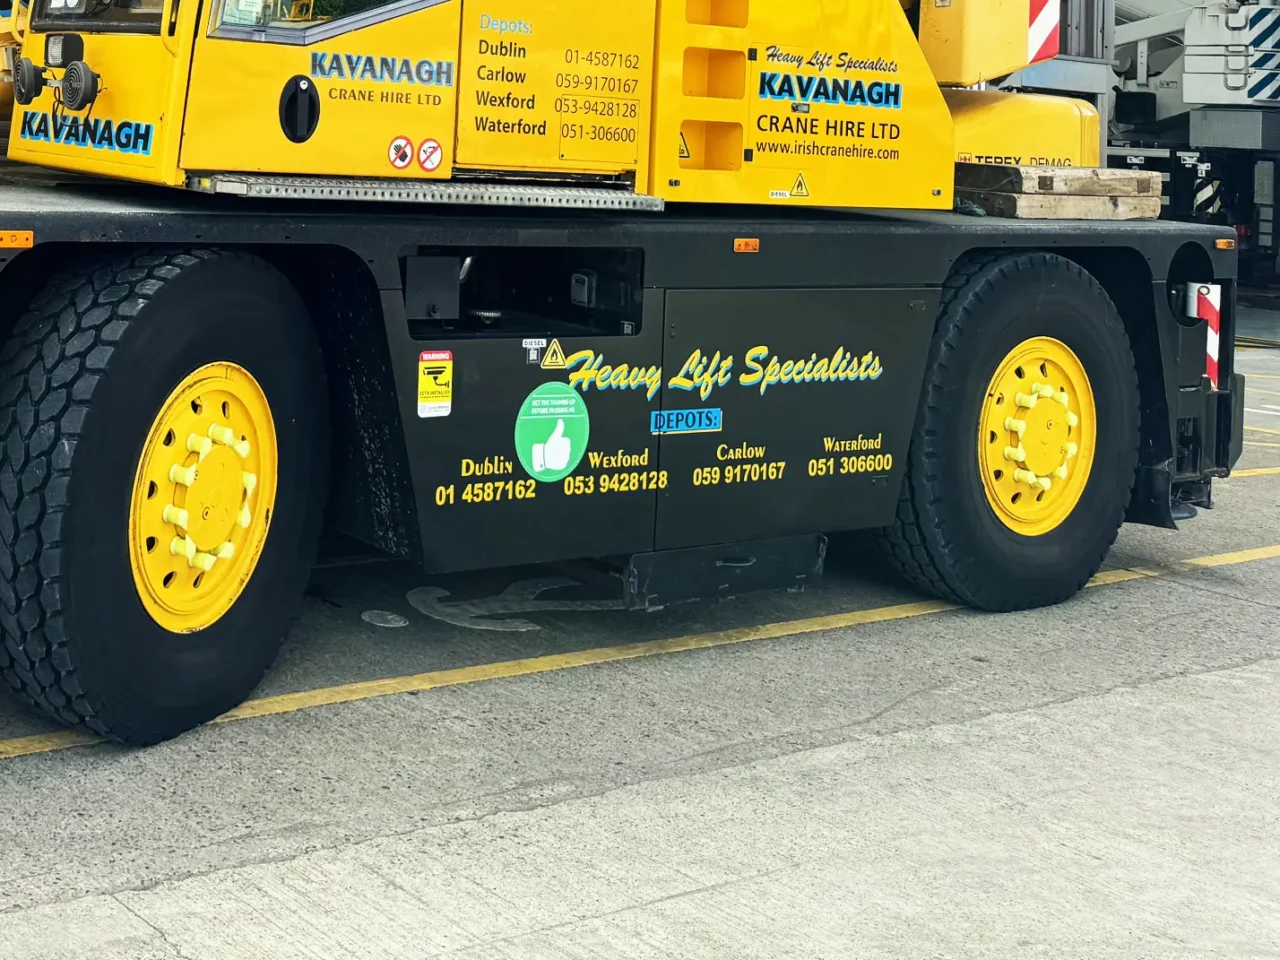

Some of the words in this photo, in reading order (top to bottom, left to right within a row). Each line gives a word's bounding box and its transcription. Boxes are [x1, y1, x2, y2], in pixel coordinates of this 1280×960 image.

[479, 14, 534, 34] Depots:
[478, 39, 527, 59] Dublin
[564, 48, 640, 70] 01-4587162
[765, 45, 804, 70] Heavy
[805, 50, 832, 71] Lift
[834, 51, 899, 74] Specialists
[310, 51, 454, 87] KAVANAGH
[477, 64, 527, 85] Carlow
[555, 72, 639, 95] 059-9170167
[328, 88, 374, 102] CRANE
[380, 90, 412, 105] HIRE
[417, 93, 442, 107] LTD
[476, 89, 536, 111] Wexford
[554, 97, 638, 120] 053-9428128
[758, 71, 903, 110] KAVANAGH
[19, 110, 155, 156] KAVANAGH
[475, 115, 547, 137] Waterford
[561, 122, 636, 144] 051-306600
[756, 114, 819, 137] CRANE
[825, 118, 865, 139] HIRE
[872, 121, 901, 141] LTD
[756, 140, 900, 161] www.irishcranehire.com
[566, 348, 662, 401] Heavy
[668, 348, 733, 400] Lift
[738, 345, 883, 396] Specialists
[653, 411, 718, 432] DEPOTS:
[693, 467, 721, 486] 059
[724, 461, 786, 484] 9170167
[808, 457, 834, 477] 051
[839, 453, 893, 474] 306600
[435, 484, 455, 506] 01
[461, 478, 537, 503] 4587162
[563, 475, 595, 496] 053
[599, 470, 669, 493] 9428128
